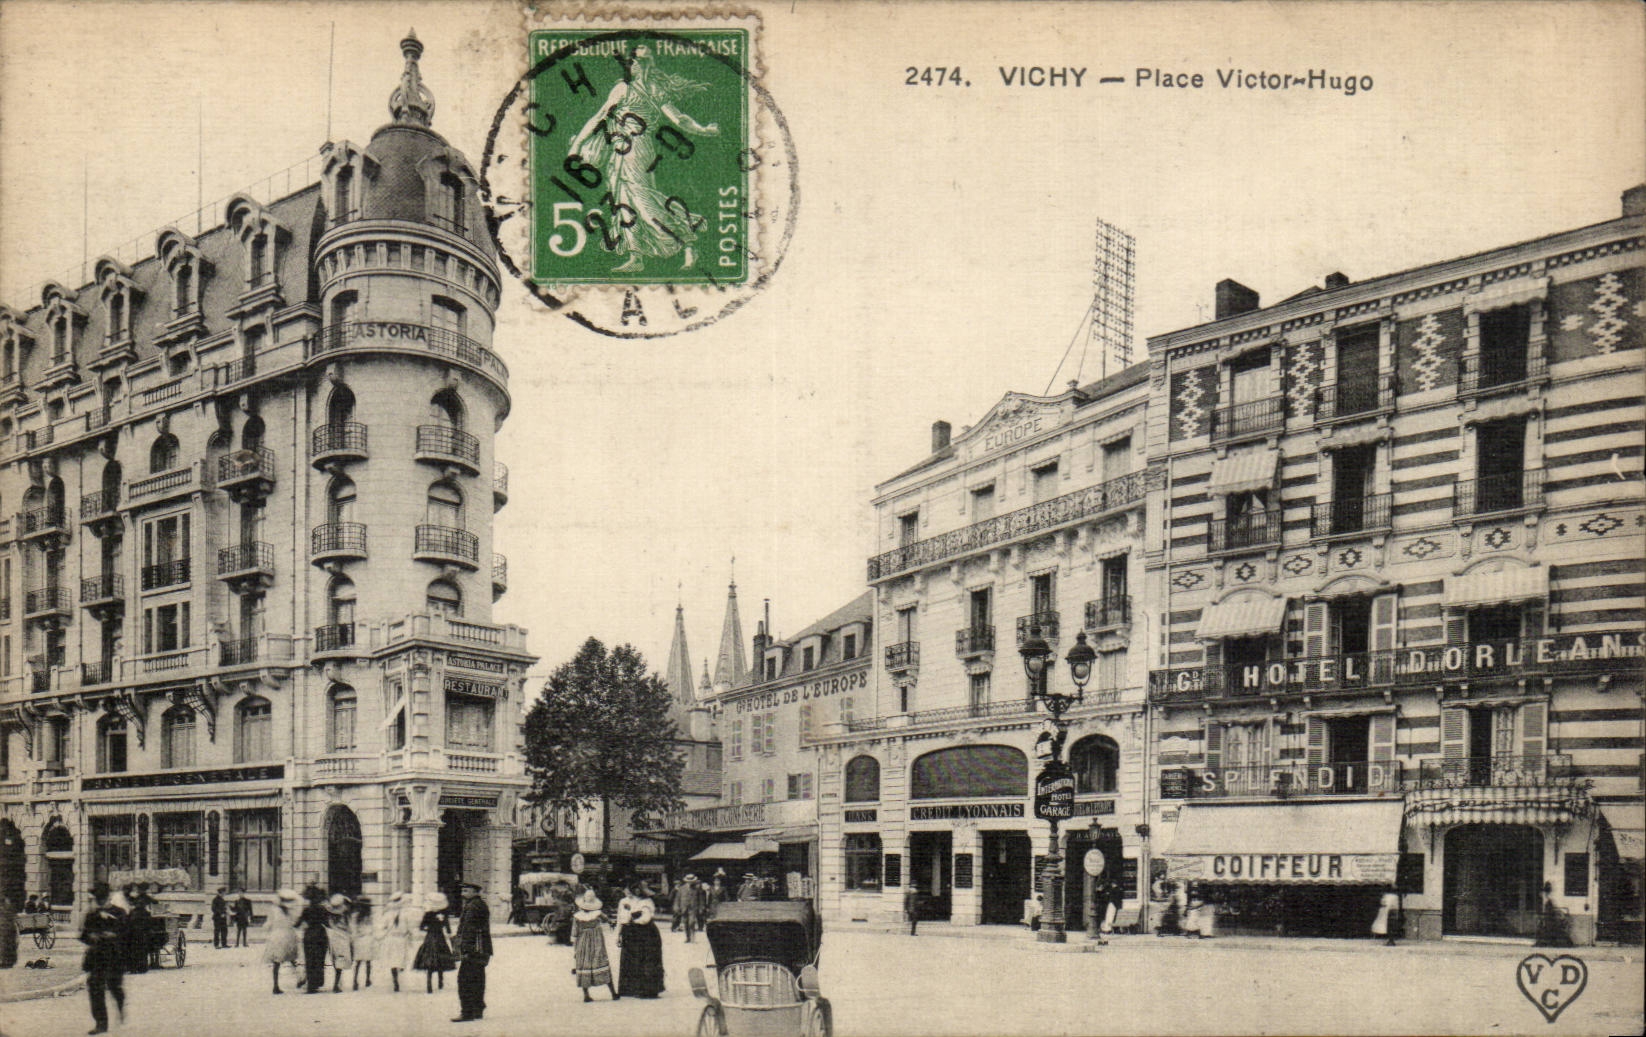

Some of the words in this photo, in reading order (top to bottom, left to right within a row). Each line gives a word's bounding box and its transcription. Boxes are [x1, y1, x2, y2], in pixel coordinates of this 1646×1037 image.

[719, 185, 738, 267] POSTES
[353, 323, 426, 342] ASTORIA
[984, 418, 1042, 451] EUROPE
[1243, 658, 1361, 688] HOTEL
[444, 679, 508, 699] RESTAURANT
[746, 692, 779, 712] HOTEL
[783, 688, 798, 704] DE
[803, 670, 868, 699] L'EUROPE
[1202, 765, 1385, 792] SPLENDID
[959, 804, 1021, 818] LYONNAIS
[1040, 804, 1071, 816] GARAGE
[1213, 855, 1343, 878] COIFFEUR
